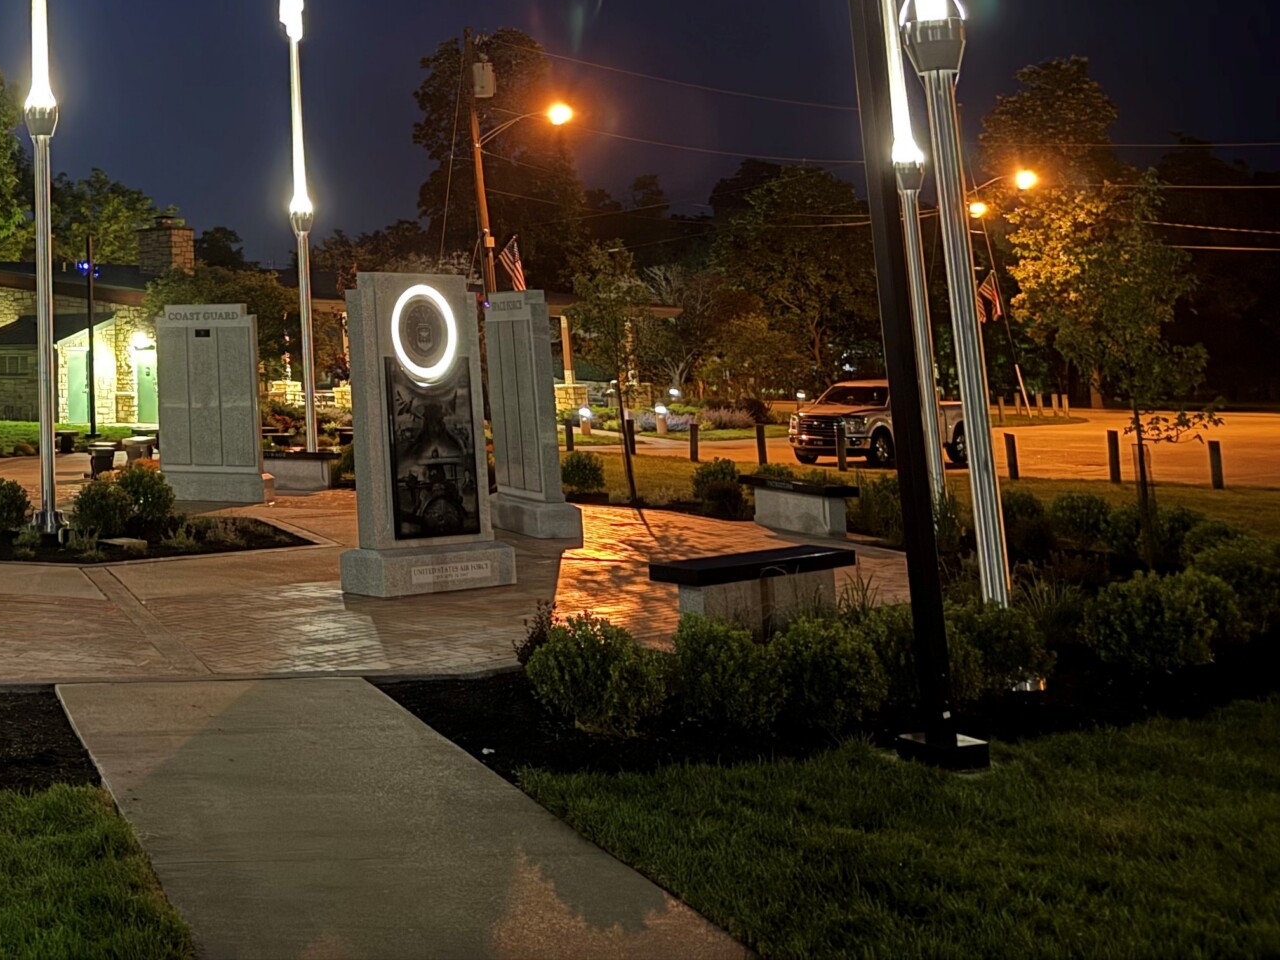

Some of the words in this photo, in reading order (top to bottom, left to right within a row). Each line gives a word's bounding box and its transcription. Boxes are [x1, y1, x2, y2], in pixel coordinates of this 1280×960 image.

[168, 311, 200, 321] COAST
[202, 311, 239, 321] GUARD
[413, 567, 437, 576] UNITED
[437, 566, 459, 574] STATES
[471, 562, 488, 570] FORCE
